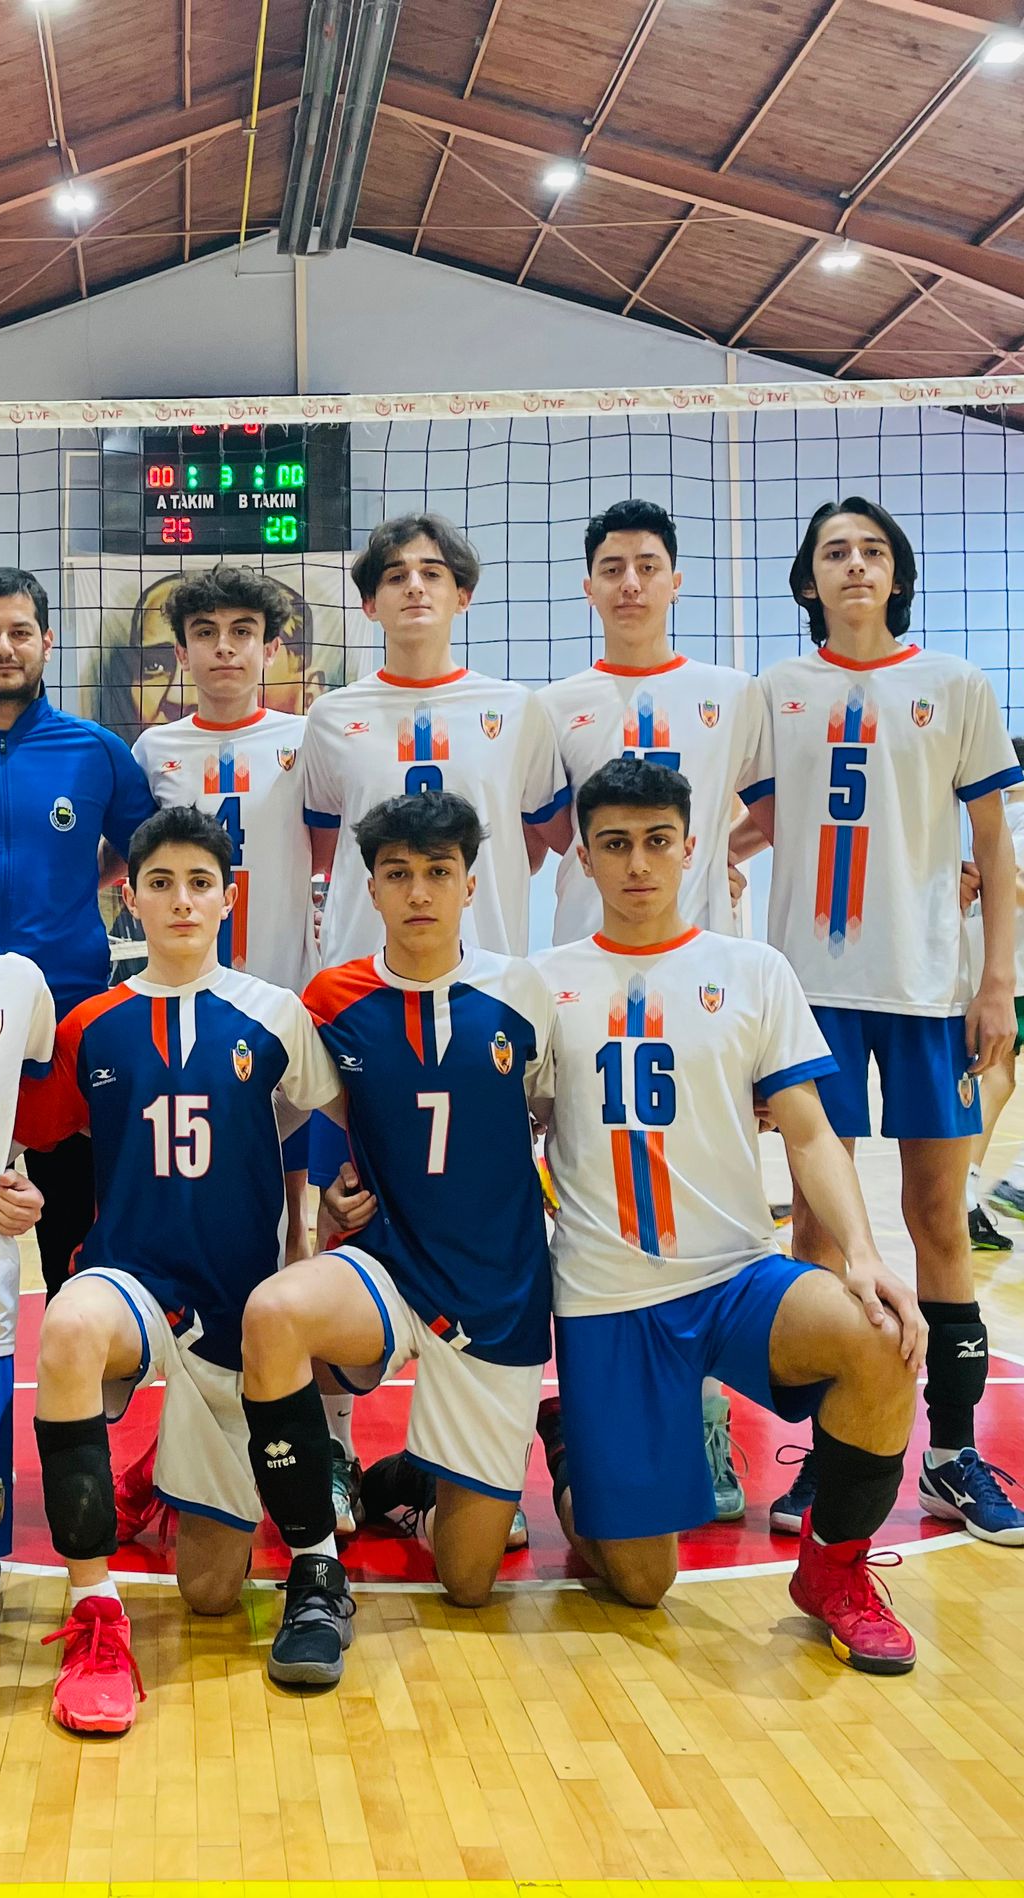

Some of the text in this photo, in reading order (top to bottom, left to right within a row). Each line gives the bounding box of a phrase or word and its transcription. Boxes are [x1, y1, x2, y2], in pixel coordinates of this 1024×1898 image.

[29, 411, 50, 419] TVF
[101, 410, 122, 419] TVF
[174, 409, 195, 417] TVF
[247, 407, 268, 415] TVF
[321, 406, 342, 414] TVF
[394, 404, 416, 412] TVF
[468, 401, 490, 410] TVF
[543, 400, 565, 408] TVF
[618, 398, 639, 407] TVF
[692, 396, 714, 404] TVF
[768, 392, 789, 401] TVF
[844, 391, 865, 399] TVF
[919, 388, 941, 397] TVF
[995, 386, 1016, 395] TVF
[148, 465, 174, 487] 00
[221, 465, 233, 488] 3
[278, 464, 303, 487] 00
[157, 494, 214, 509] A TAKIM
[239, 494, 296, 508] B TAKIM
[265, 516, 297, 543] 20
[829, 748, 867, 820] 5
[596, 1042, 676, 1125] 16
[143, 1094, 212, 1179] 15
[416, 1091, 450, 1174] 7
